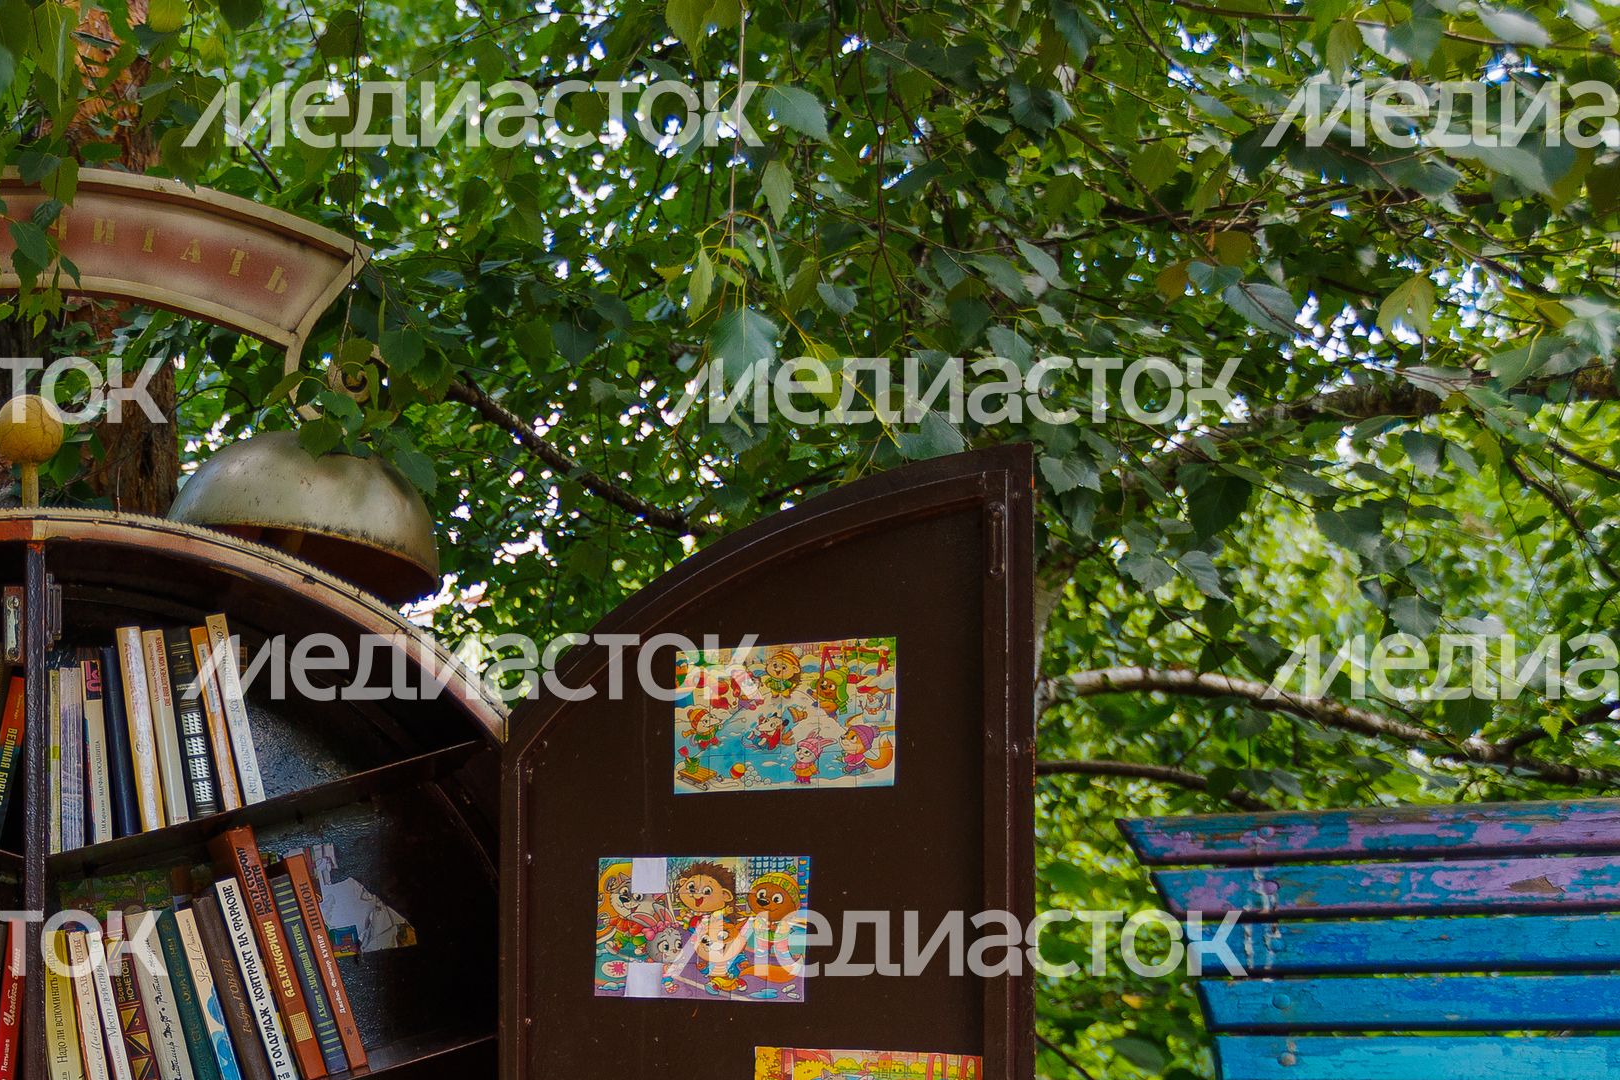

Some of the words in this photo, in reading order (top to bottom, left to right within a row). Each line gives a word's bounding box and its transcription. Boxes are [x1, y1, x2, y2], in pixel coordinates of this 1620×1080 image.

[50, 214, 288, 296] ЧИТАТЬ
[160, 666, 169, 696] BIBLIOTHEK
[0, 727, 18, 769] ВЕЛИКАЯ
[236, 847, 257, 887] СТОРОНУ
[248, 887, 259, 900] ТУ
[252, 865, 273, 914] РАСЦВЕТА
[222, 885, 245, 932] ФАРАОНЕ
[253, 900, 265, 916] ПО
[300, 881, 321, 931] ШПИОН
[238, 934, 249, 948] НА
[291, 924, 306, 951] МАТЕРИК
[316, 934, 329, 958] КУПЕР
[244, 950, 266, 999] КОНТРАКТ
[2, 981, 18, 1026] Улыбка
[50, 977, 63, 1027] вспоминать
[334, 990, 347, 1014] Джеймс
[58, 1029, 65, 1040] ли
[105, 1007, 118, 1039] Место
[134, 1018, 141, 1026] 2
[259, 1007, 282, 1057] ОЛДРИДЖ
[56, 1040, 68, 1063] Надо
